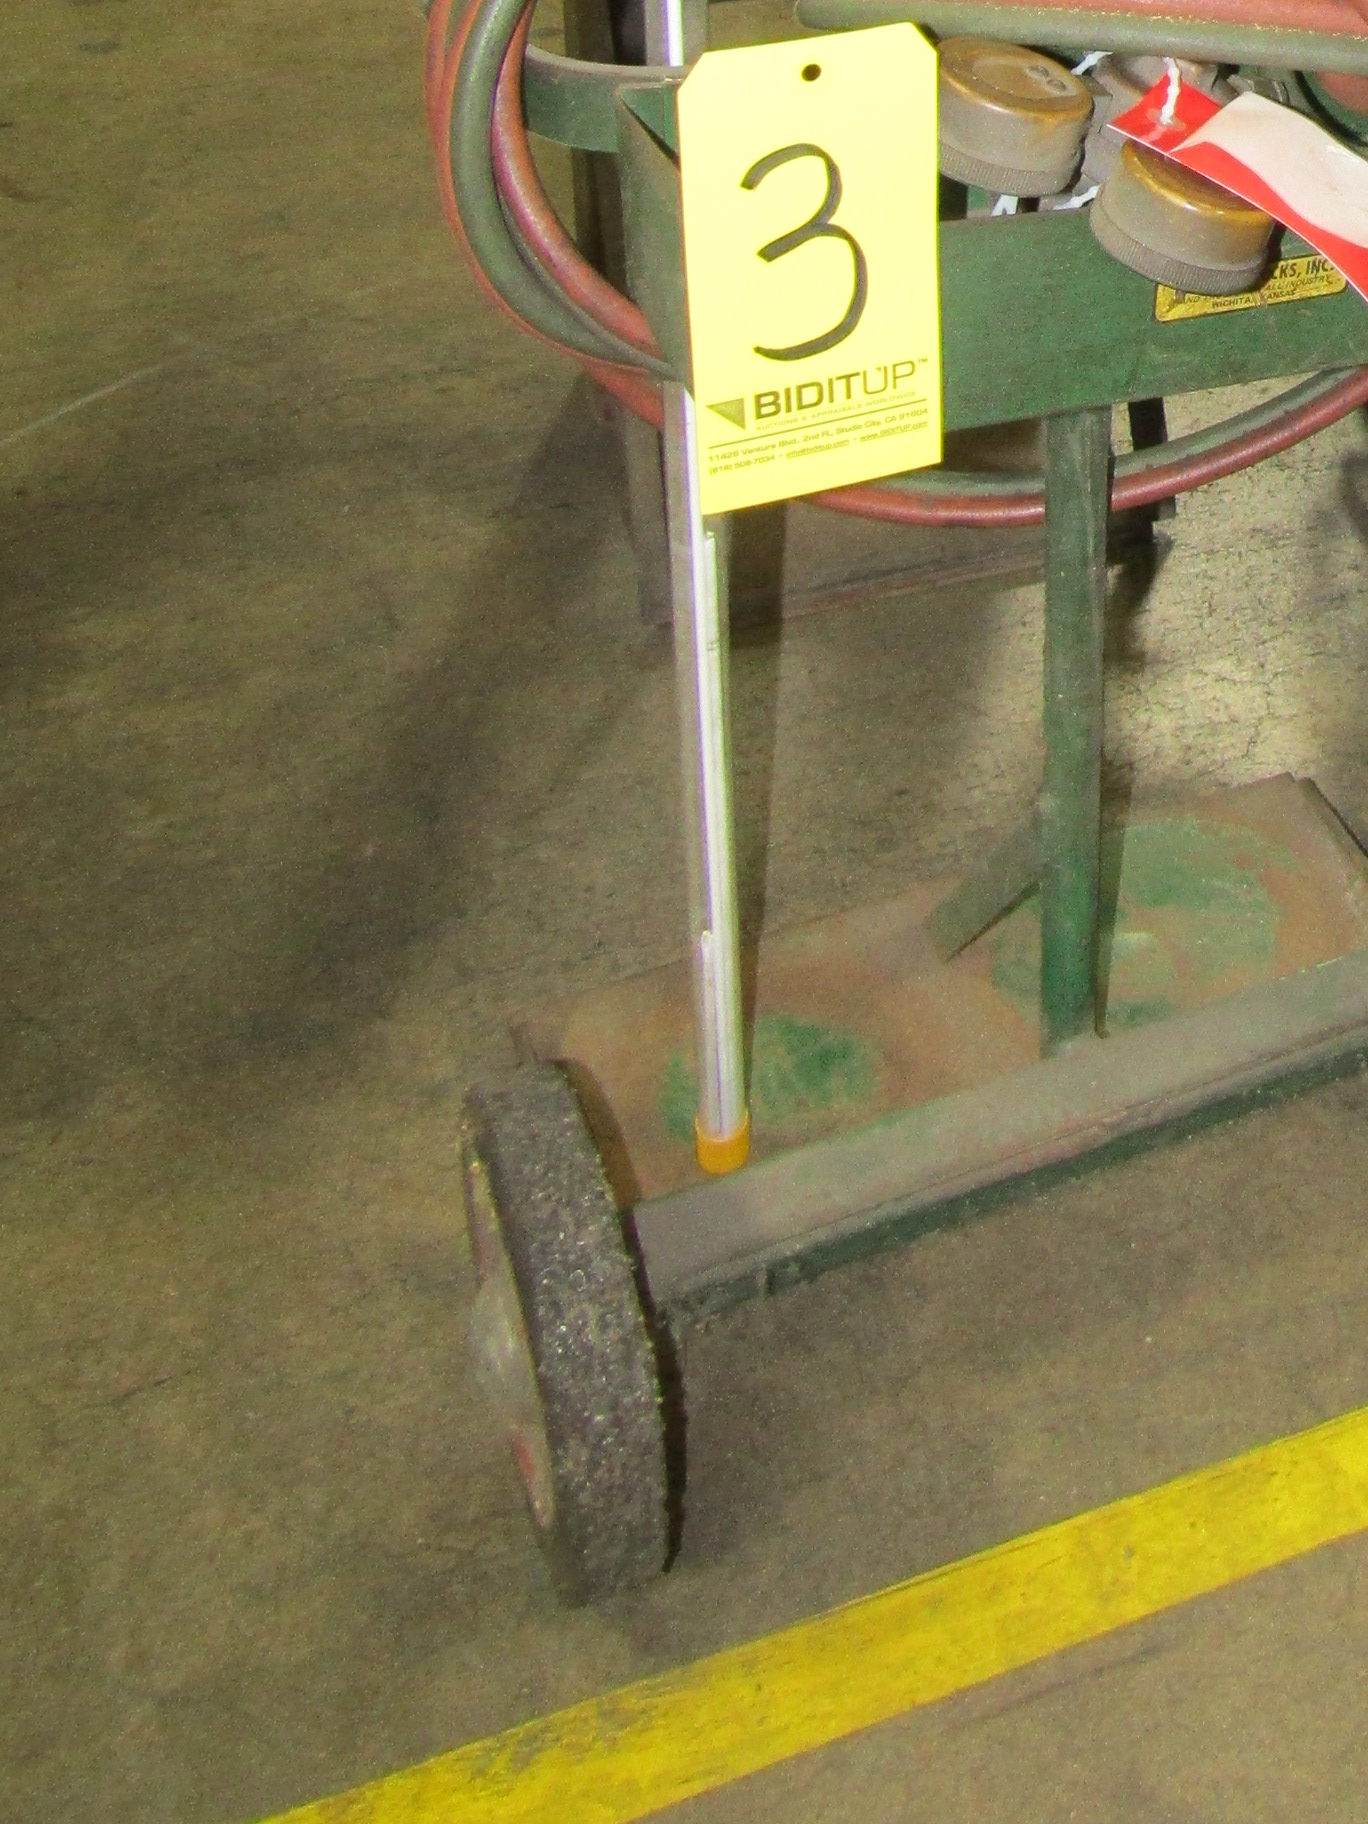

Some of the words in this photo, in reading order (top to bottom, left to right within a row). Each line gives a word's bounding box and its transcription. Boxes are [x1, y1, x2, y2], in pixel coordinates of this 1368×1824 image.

[740, 142, 868, 362] 3
[1271, 262, 1302, 280] KS,
[1266, 288, 1297, 300] ANSAS
[754, 360, 915, 420] BIDITUP
[756, 417, 798, 431] AUCTIONS
[811, 403, 862, 419] APPRAISALS
[865, 390, 916, 407] WORLDWIDE
[708, 449, 739, 463] 11426
[803, 432, 819, 443] 2nd
[836, 423, 863, 435] Studio
[884, 415, 897, 424] CA
